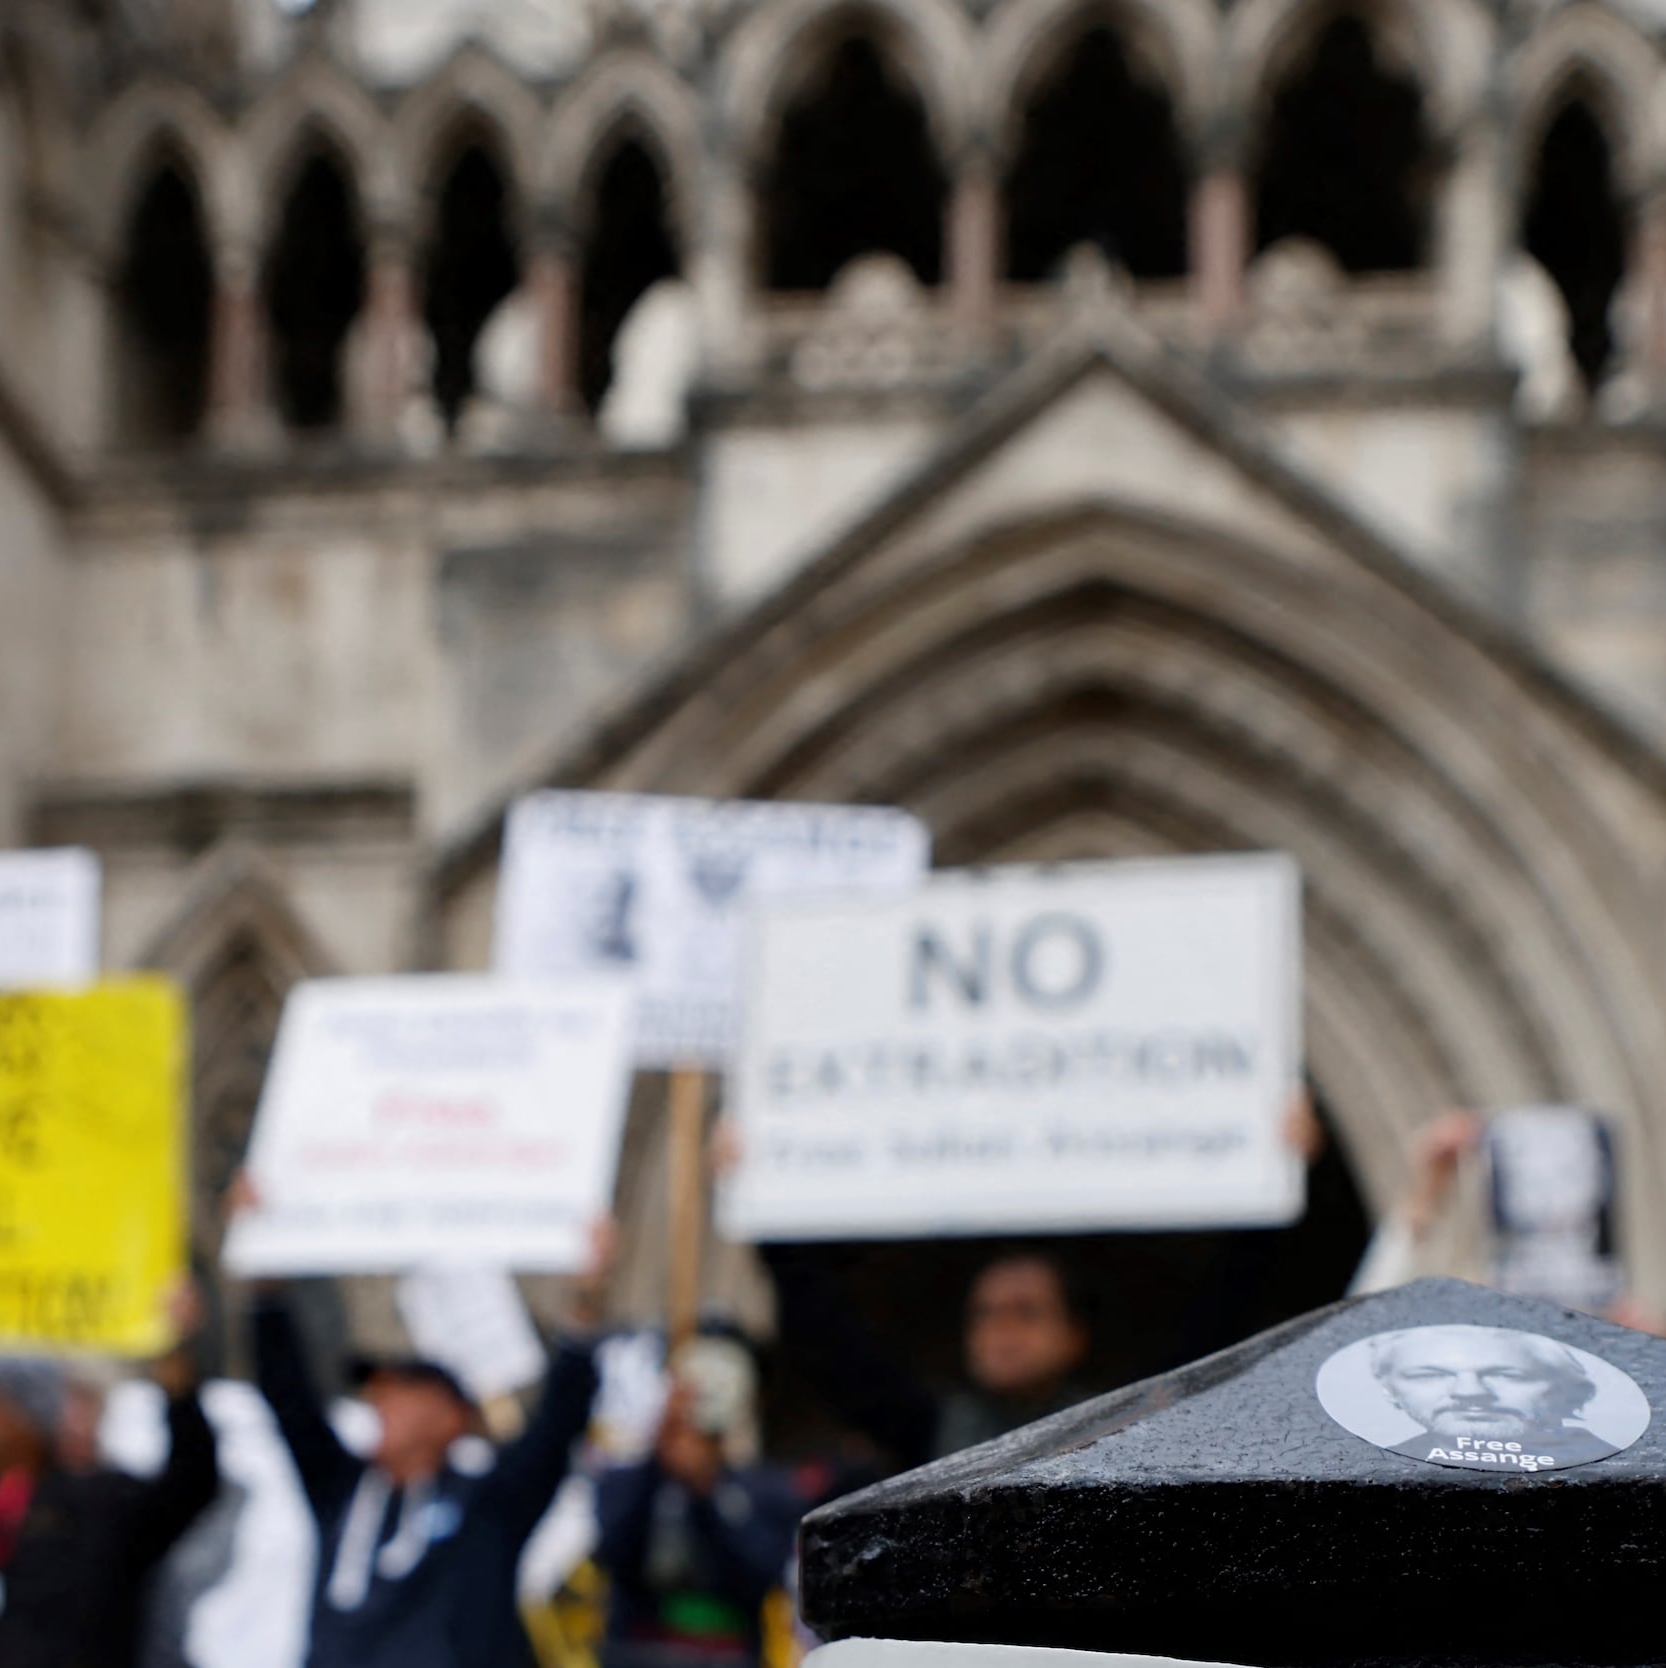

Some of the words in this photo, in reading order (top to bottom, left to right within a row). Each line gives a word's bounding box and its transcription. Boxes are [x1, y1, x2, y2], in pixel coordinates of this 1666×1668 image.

[906, 910, 1106, 1013] NO
[1457, 1437, 1522, 1452] Free
[1427, 1448, 1555, 1472] Assange
